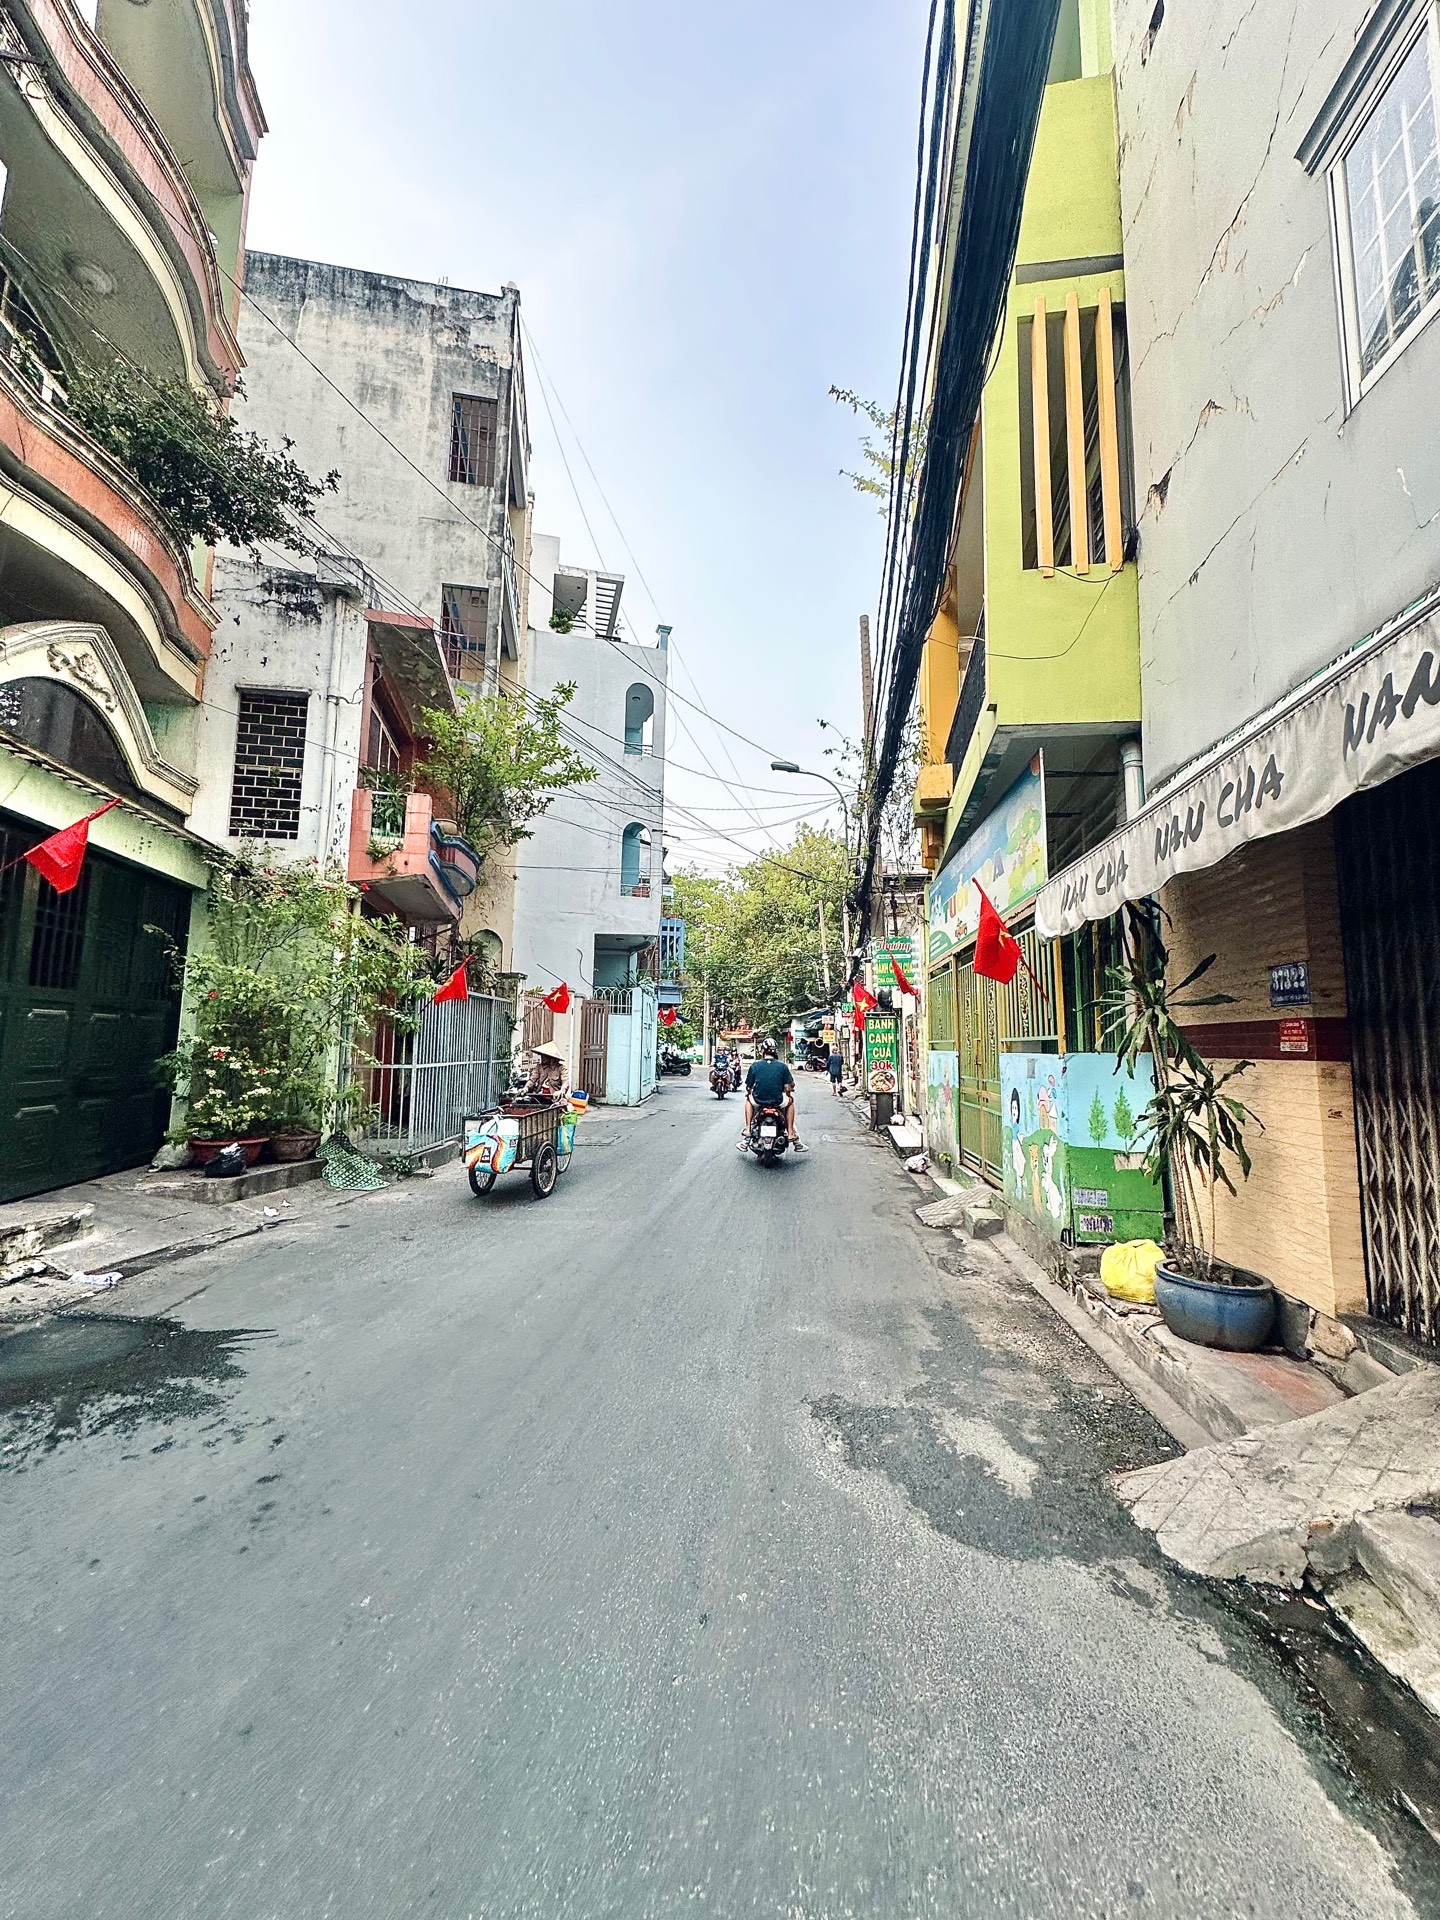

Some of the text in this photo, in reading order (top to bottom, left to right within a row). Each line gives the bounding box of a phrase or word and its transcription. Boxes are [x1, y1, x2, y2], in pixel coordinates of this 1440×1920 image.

[1154, 753, 1285, 866] NAN CHA
[1095, 849, 1129, 896] CHA
[868, 1019, 894, 1030] BANH
[868, 1033, 895, 1044] CANH
[872, 1047, 892, 1058] CUA
